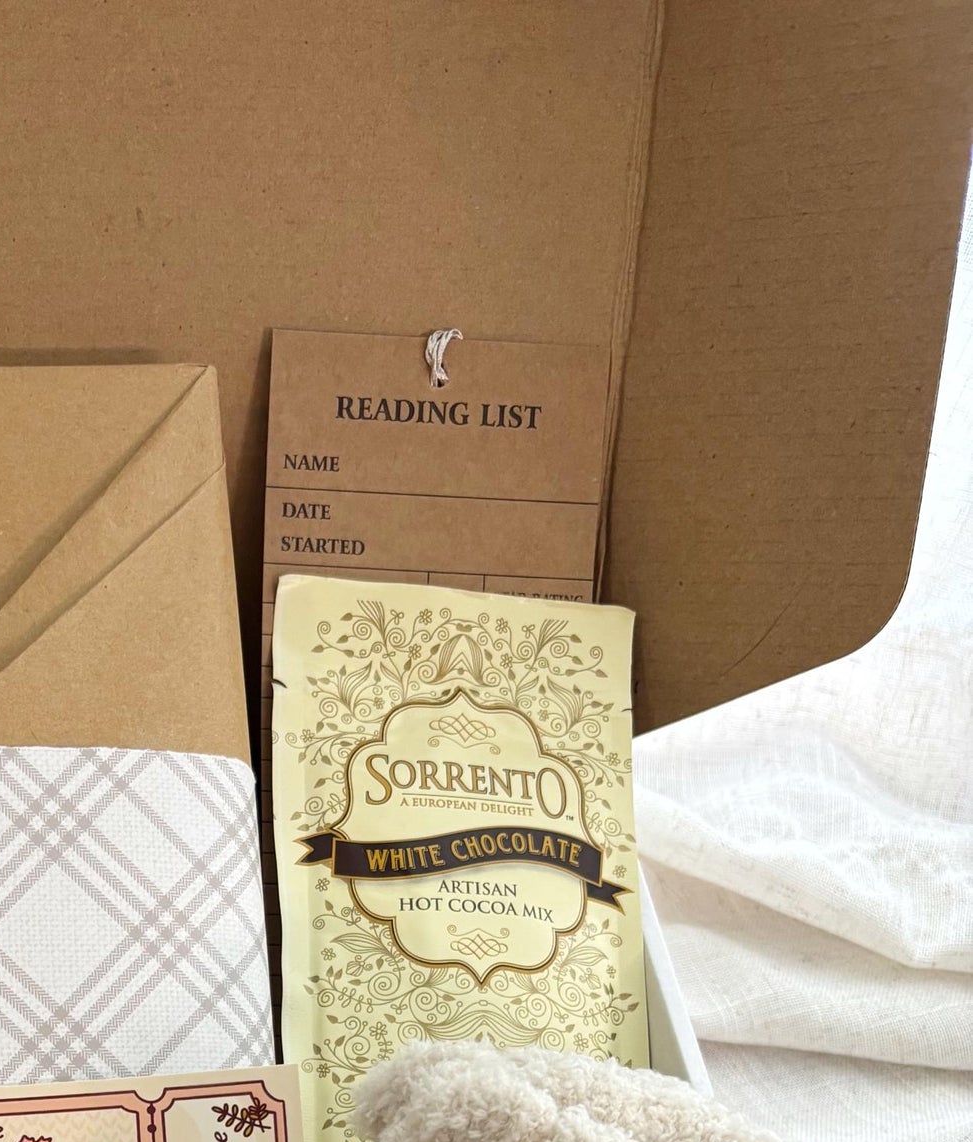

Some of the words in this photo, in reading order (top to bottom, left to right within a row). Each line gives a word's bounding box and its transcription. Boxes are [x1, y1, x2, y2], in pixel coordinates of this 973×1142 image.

[335, 395, 470, 427] READING
[480, 403, 543, 430] LIST
[283, 453, 340, 473] NAME
[281, 502, 332, 521] DATE
[280, 535, 366, 556] STARTED
[364, 753, 568, 821] SORRENTO
[400, 798, 409, 807] A
[412, 797, 478, 811] EUROPEAN
[480, 803, 535, 817] DELIGHT
[365, 843, 448, 873] WHITE
[450, 831, 584, 868] CHOCOLATE
[437, 879, 518, 898] ARTISAN
[399, 897, 444, 912] HOT
[447, 898, 518, 918] COCOA
[522, 904, 554, 923] MIX
